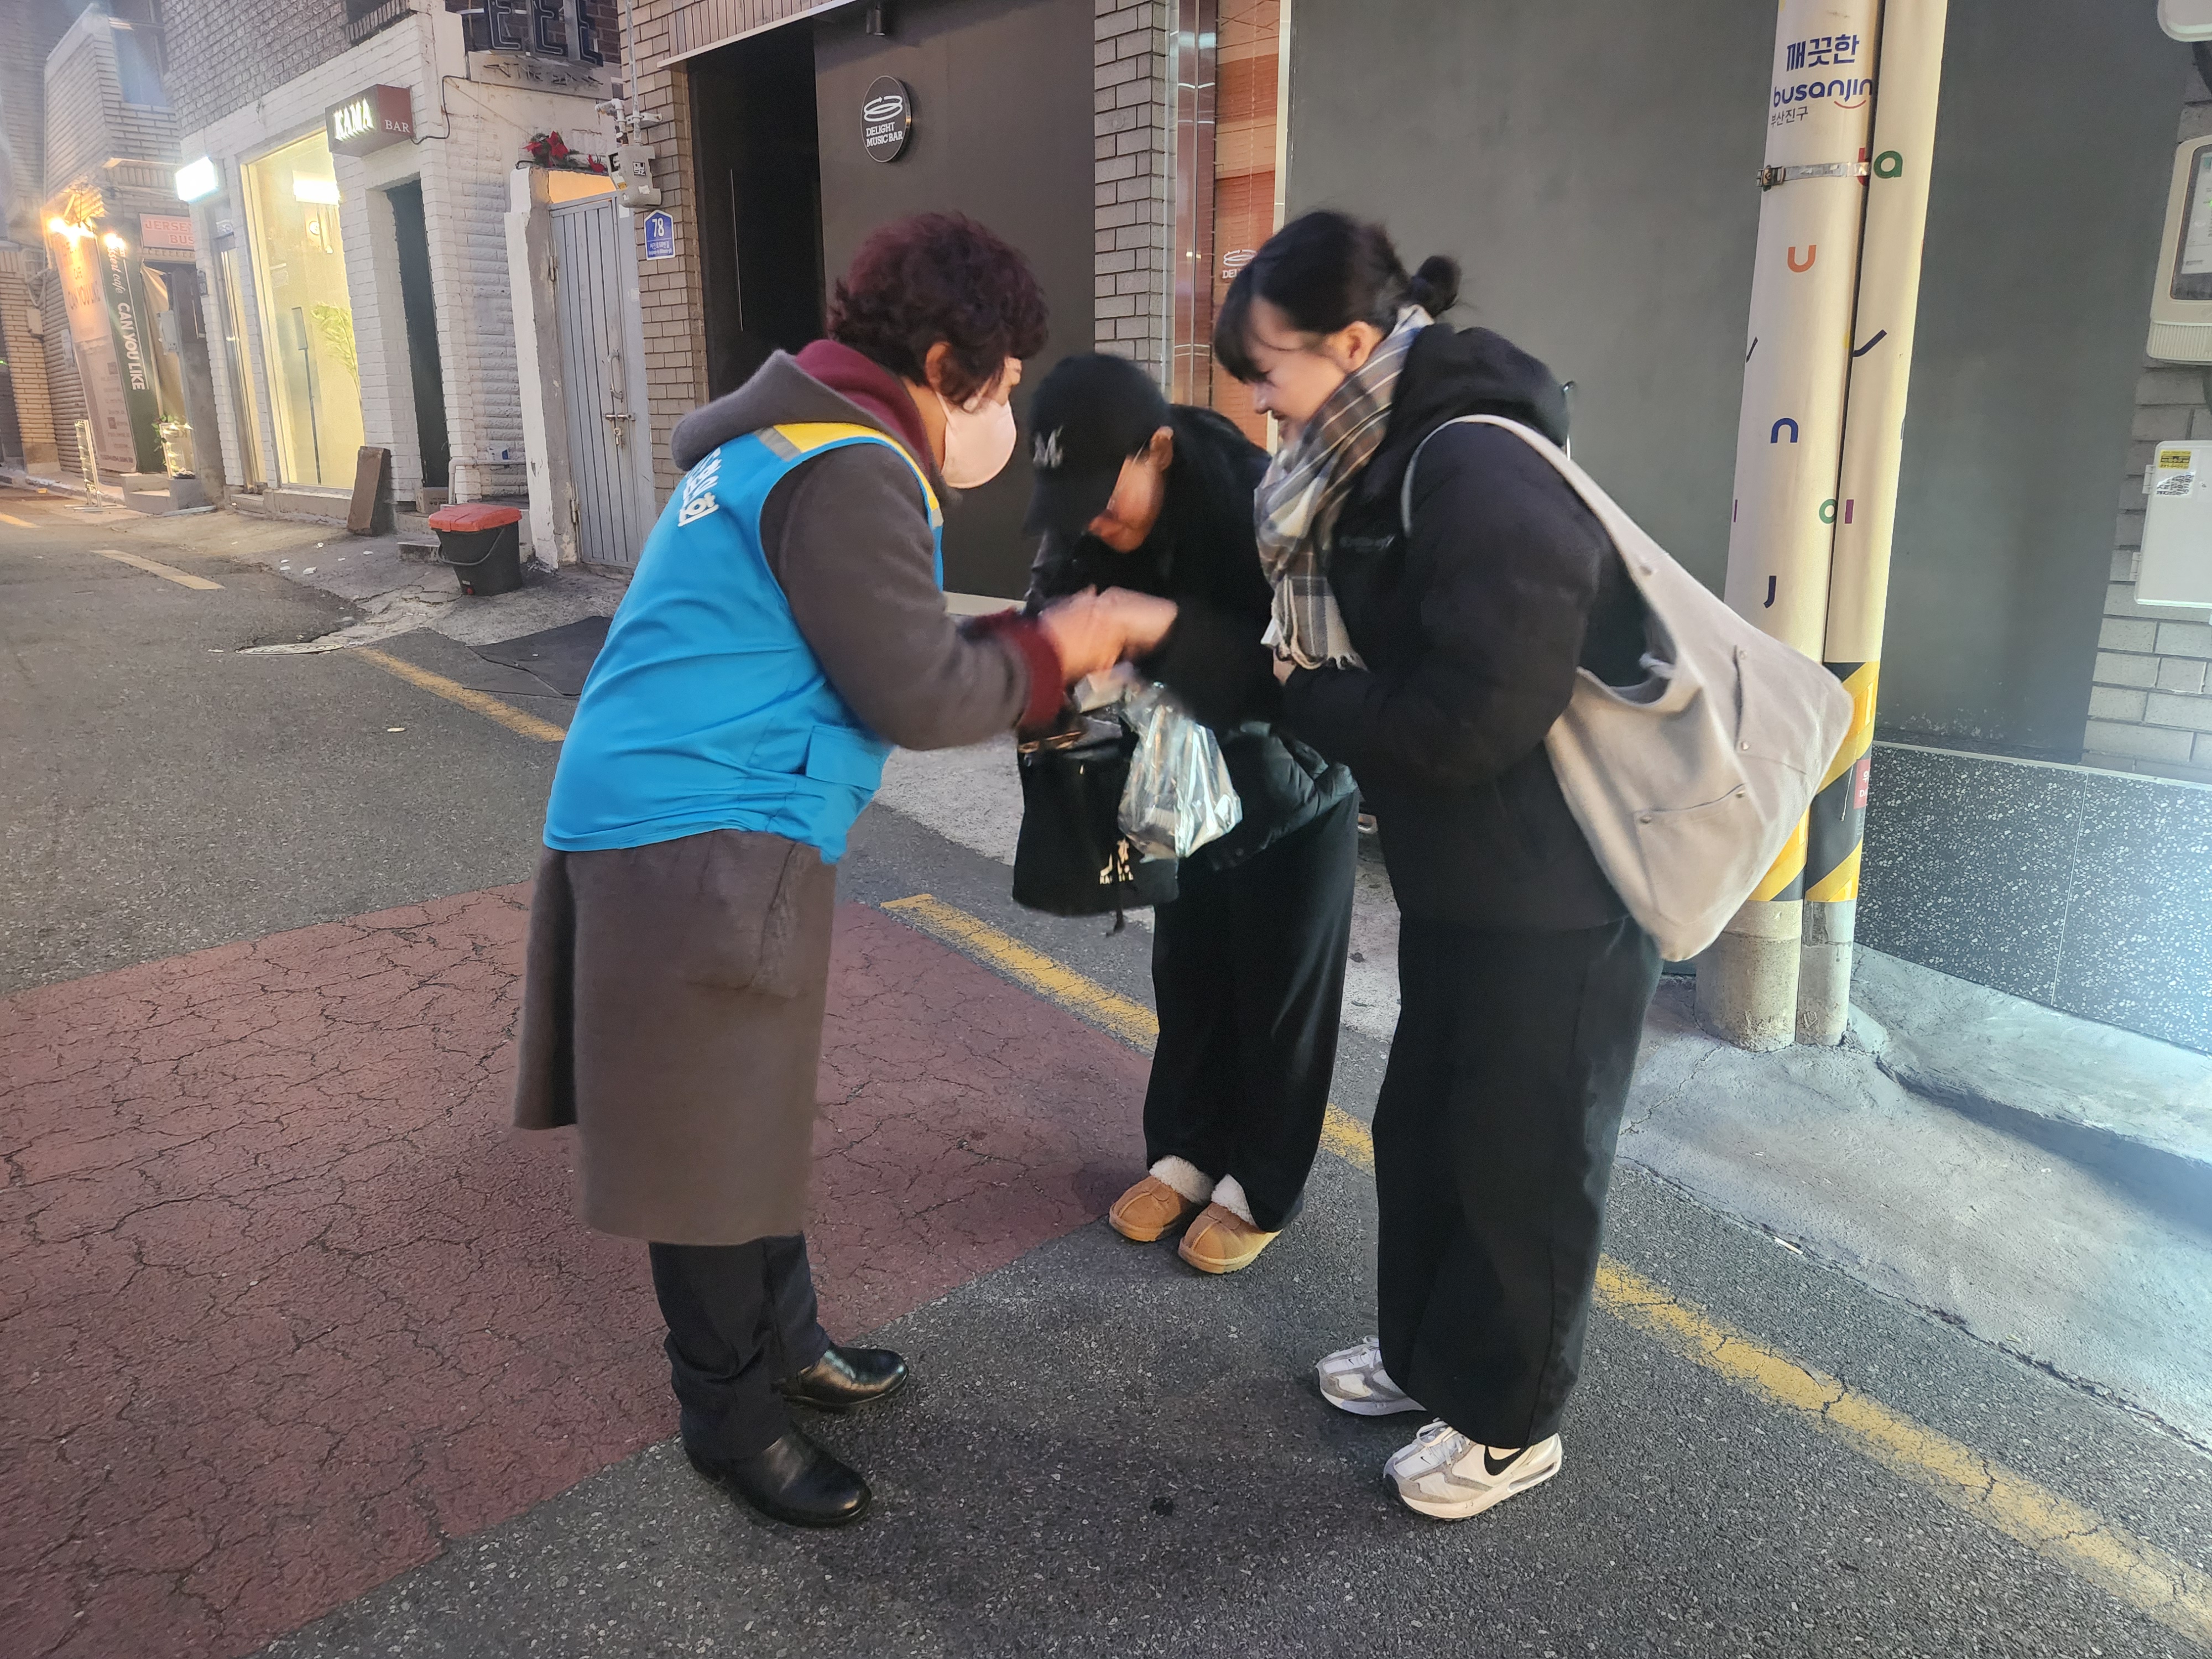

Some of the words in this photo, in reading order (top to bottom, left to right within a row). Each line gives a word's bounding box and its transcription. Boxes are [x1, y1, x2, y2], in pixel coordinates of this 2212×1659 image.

[1786, 34, 1860, 72] 깨끗한
[1773, 79, 1873, 108] busanjin
[334, 98, 375, 142] KAMA
[385, 119, 410, 133] BAR
[866, 122, 895, 137] DELIGHT
[1771, 106, 1809, 128] 부산진구
[867, 134, 888, 147] MUSIC
[889, 131, 903, 142] BAR
[652, 217, 665, 237] 78
[117, 302, 134, 331] CAN
[123, 332, 139, 359] YOU
[128, 362, 145, 390] LIKE
